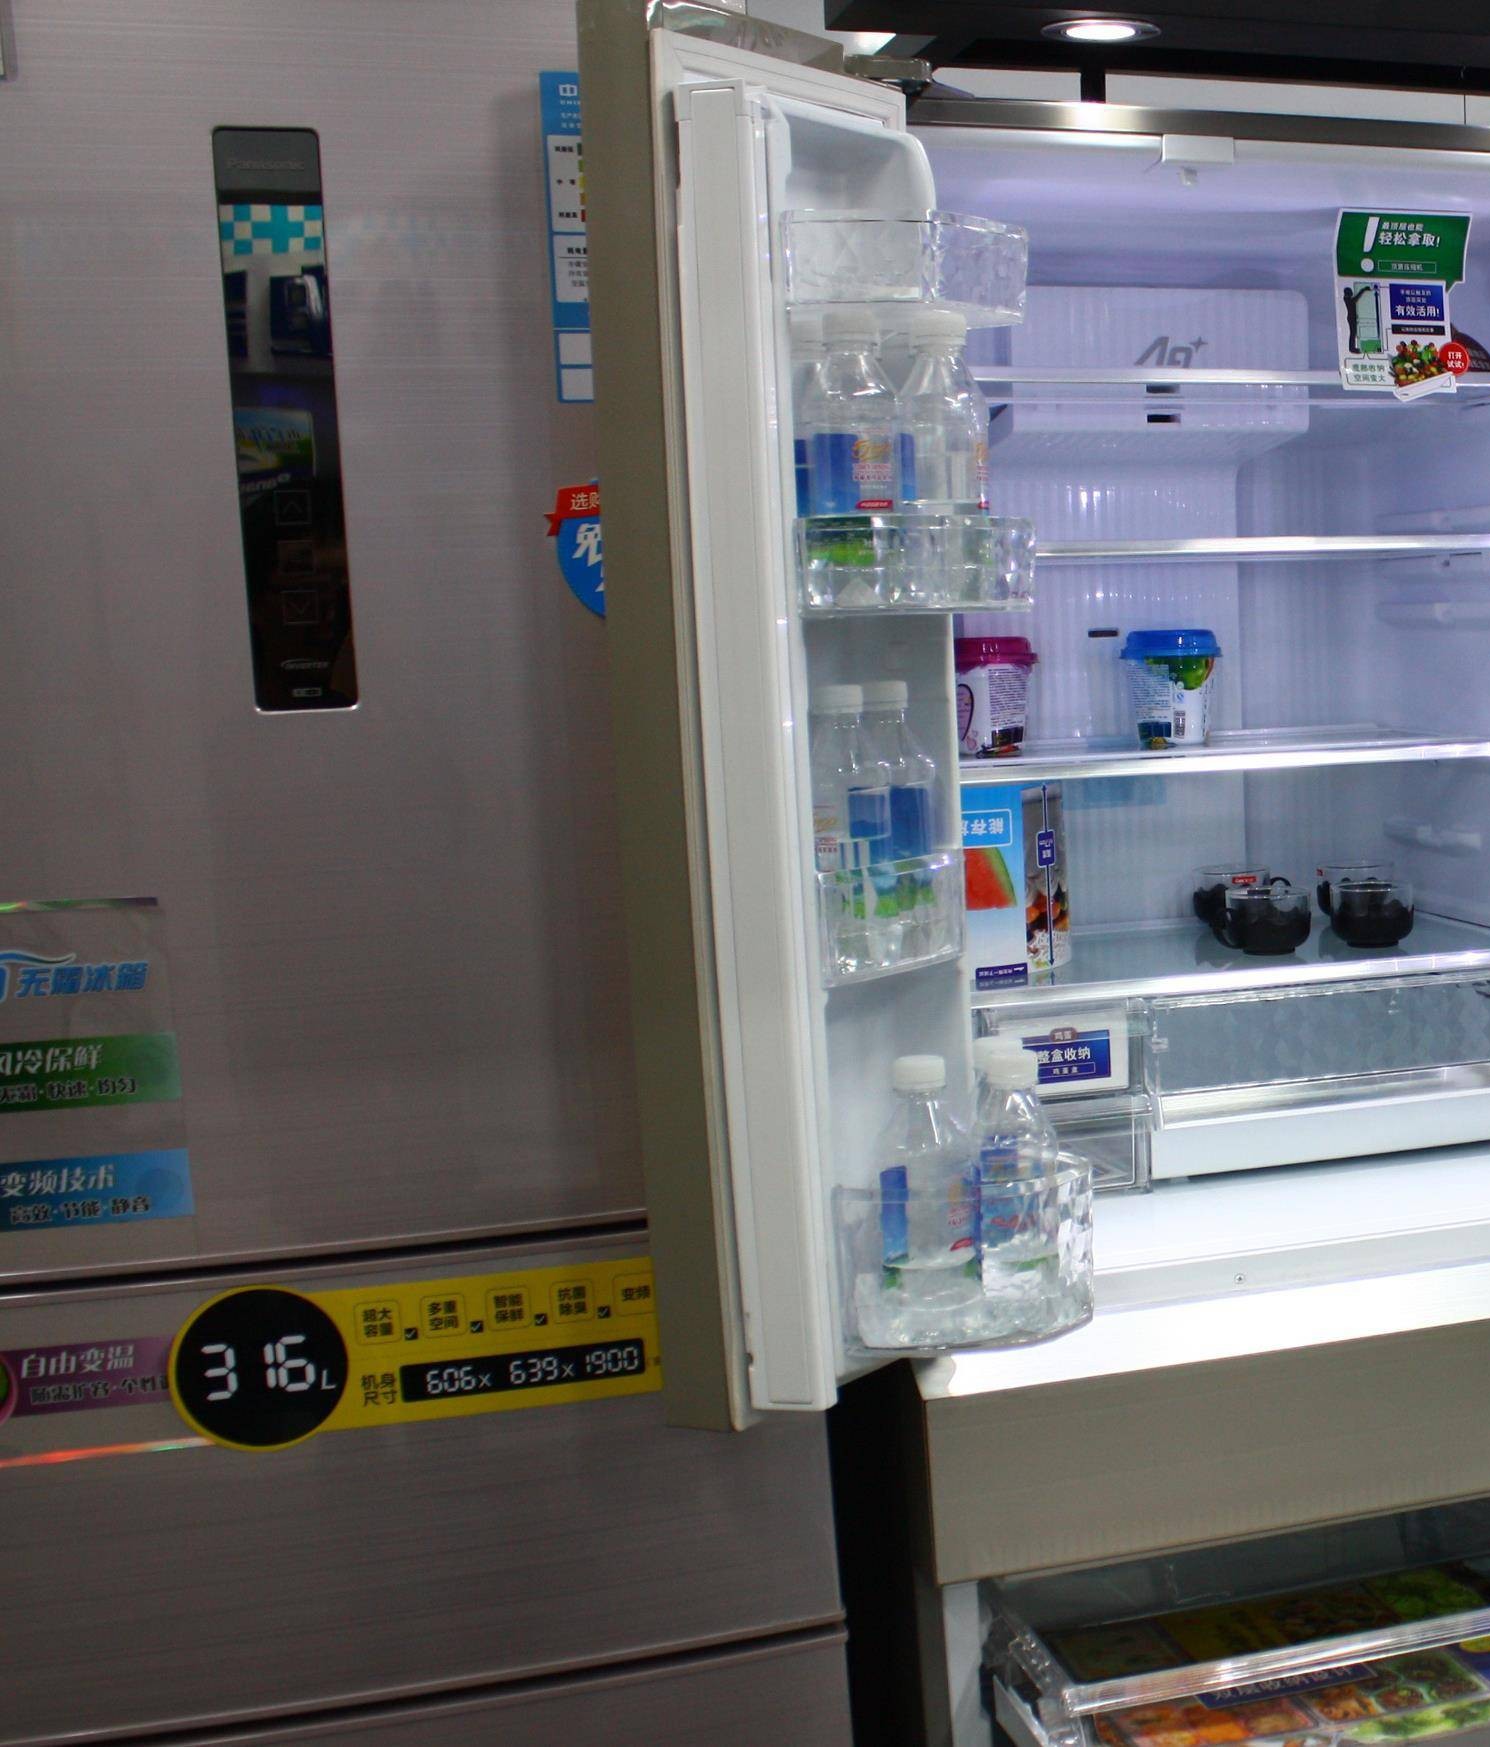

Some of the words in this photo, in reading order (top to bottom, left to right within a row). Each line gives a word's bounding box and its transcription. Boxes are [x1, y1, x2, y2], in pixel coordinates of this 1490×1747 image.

[1379, 232, 1440, 247] 轻松拿取!
[1396, 305, 1440, 317] 有效活用!
[1037, 1047, 1091, 1064] 整盒收纳
[1, 1163, 116, 1199] 变频技术
[363, 1307, 392, 1322] 超大
[428, 1300, 457, 1315] 多重
[364, 1322, 394, 1337] 容量
[429, 1315, 458, 1331] 空间
[21, 1344, 134, 1379] 自由变温
[585, 1346, 639, 1373] 1900
[361, 1373, 396, 1390] 机身
[363, 1390, 397, 1406] 尺寸
